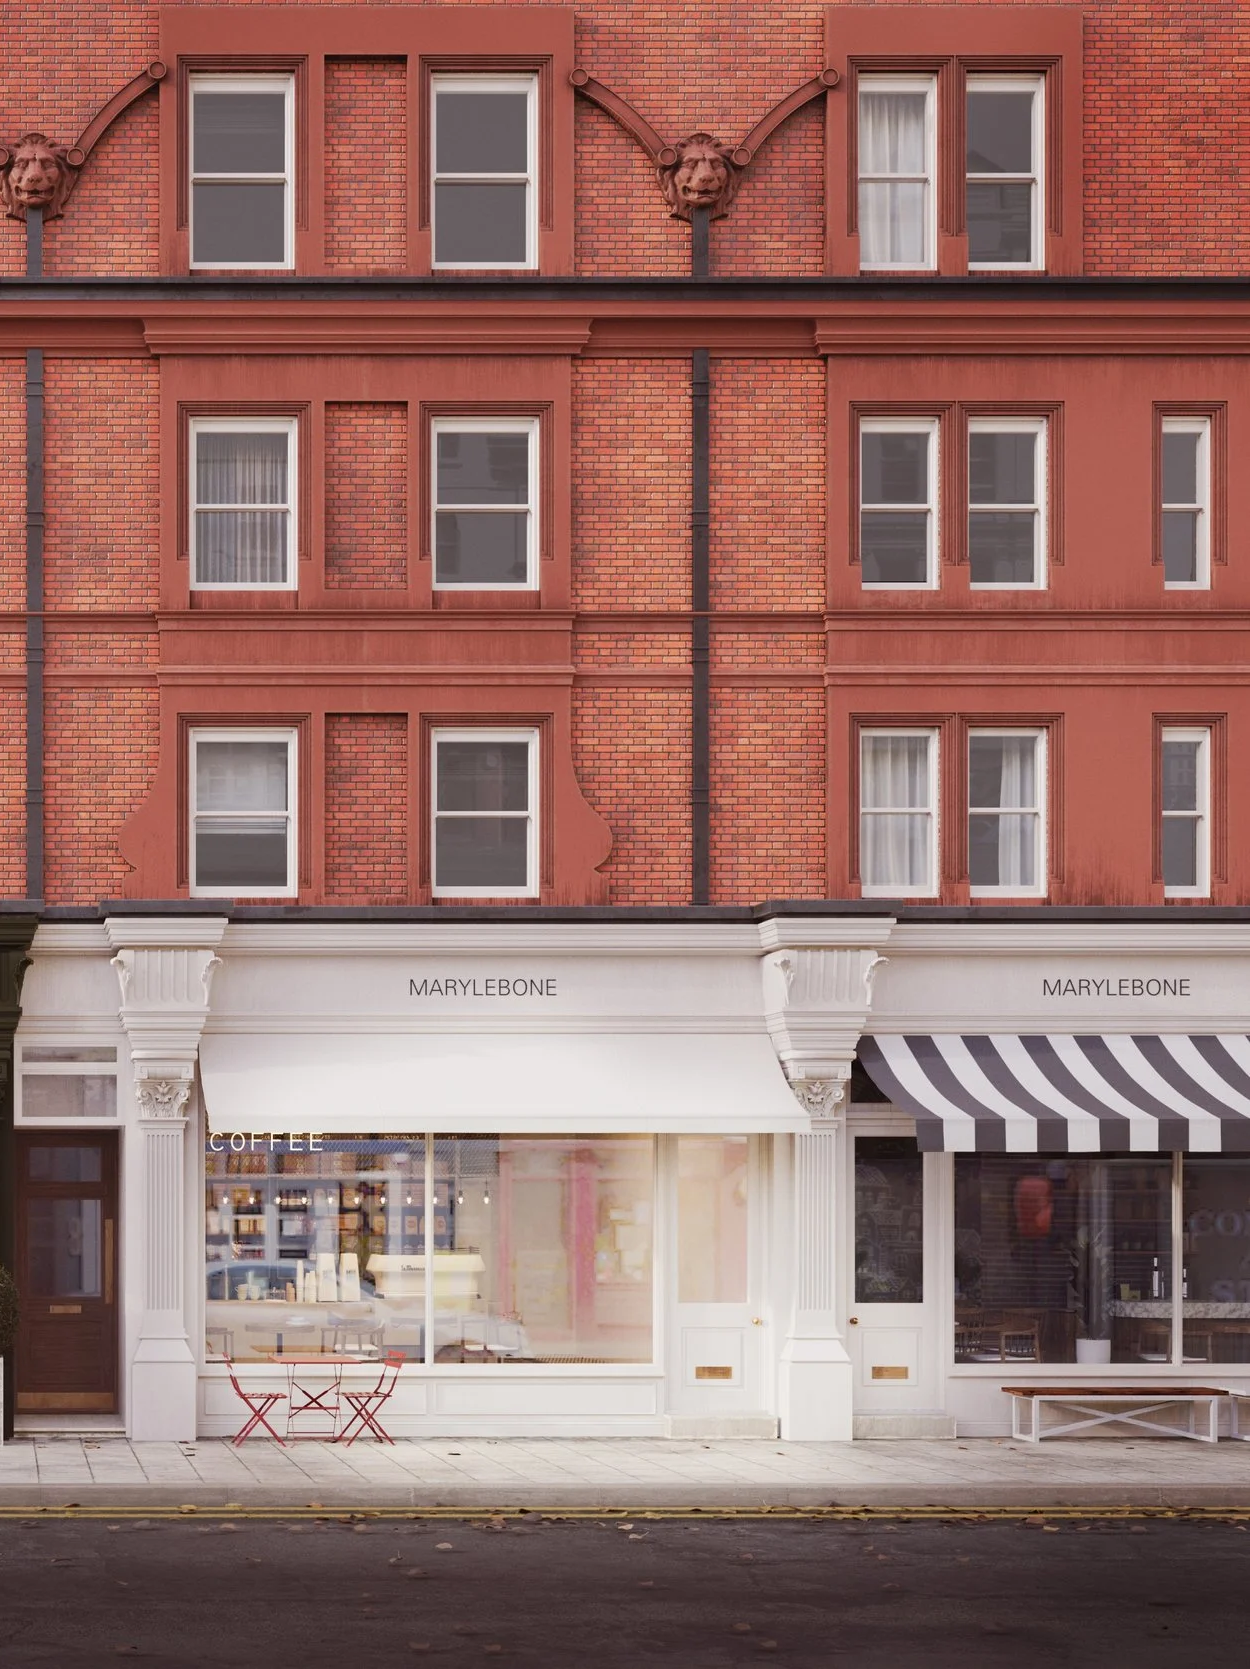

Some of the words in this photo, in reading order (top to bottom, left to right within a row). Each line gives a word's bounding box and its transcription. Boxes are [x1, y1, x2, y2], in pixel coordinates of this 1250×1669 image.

[410, 979, 557, 996] MARYLEBONE
[1043, 979, 1190, 996] MARYLEBONE
[210, 1132, 323, 1151] COFFEE
